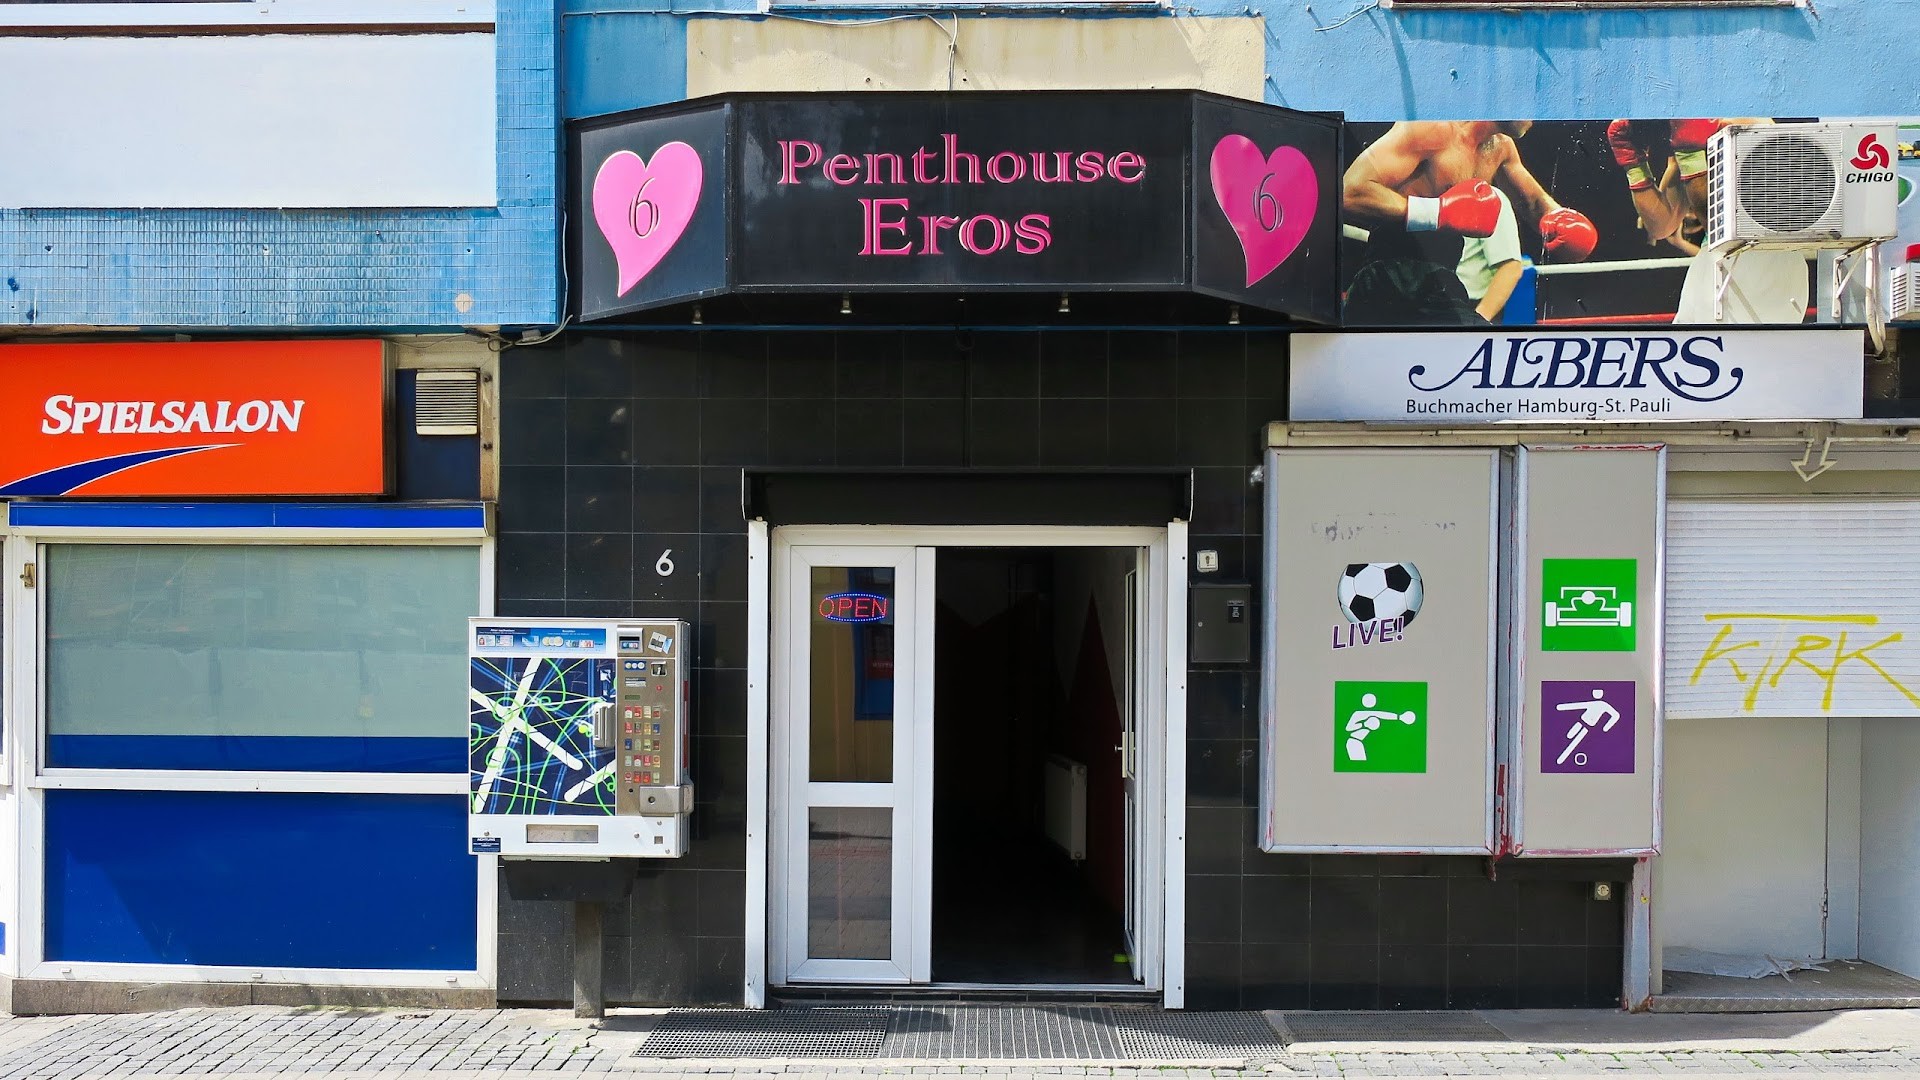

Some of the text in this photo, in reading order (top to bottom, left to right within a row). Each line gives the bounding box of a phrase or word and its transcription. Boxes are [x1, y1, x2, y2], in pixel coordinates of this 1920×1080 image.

[777, 133, 1146, 184] Penthouse
[1846, 172, 1894, 183] CHIGO
[629, 177, 660, 239] 6
[1253, 173, 1283, 232] 6
[857, 198, 1052, 256] Eros
[1409, 336, 1743, 402] ALBERS
[42, 395, 304, 434] SPIELSALON
[1406, 398, 1671, 415] Buchmacher Hamburg-St. Pauli
[655, 549, 674, 577] 6
[819, 598, 888, 618] OPEN
[1332, 616, 1404, 650] LIVE!
